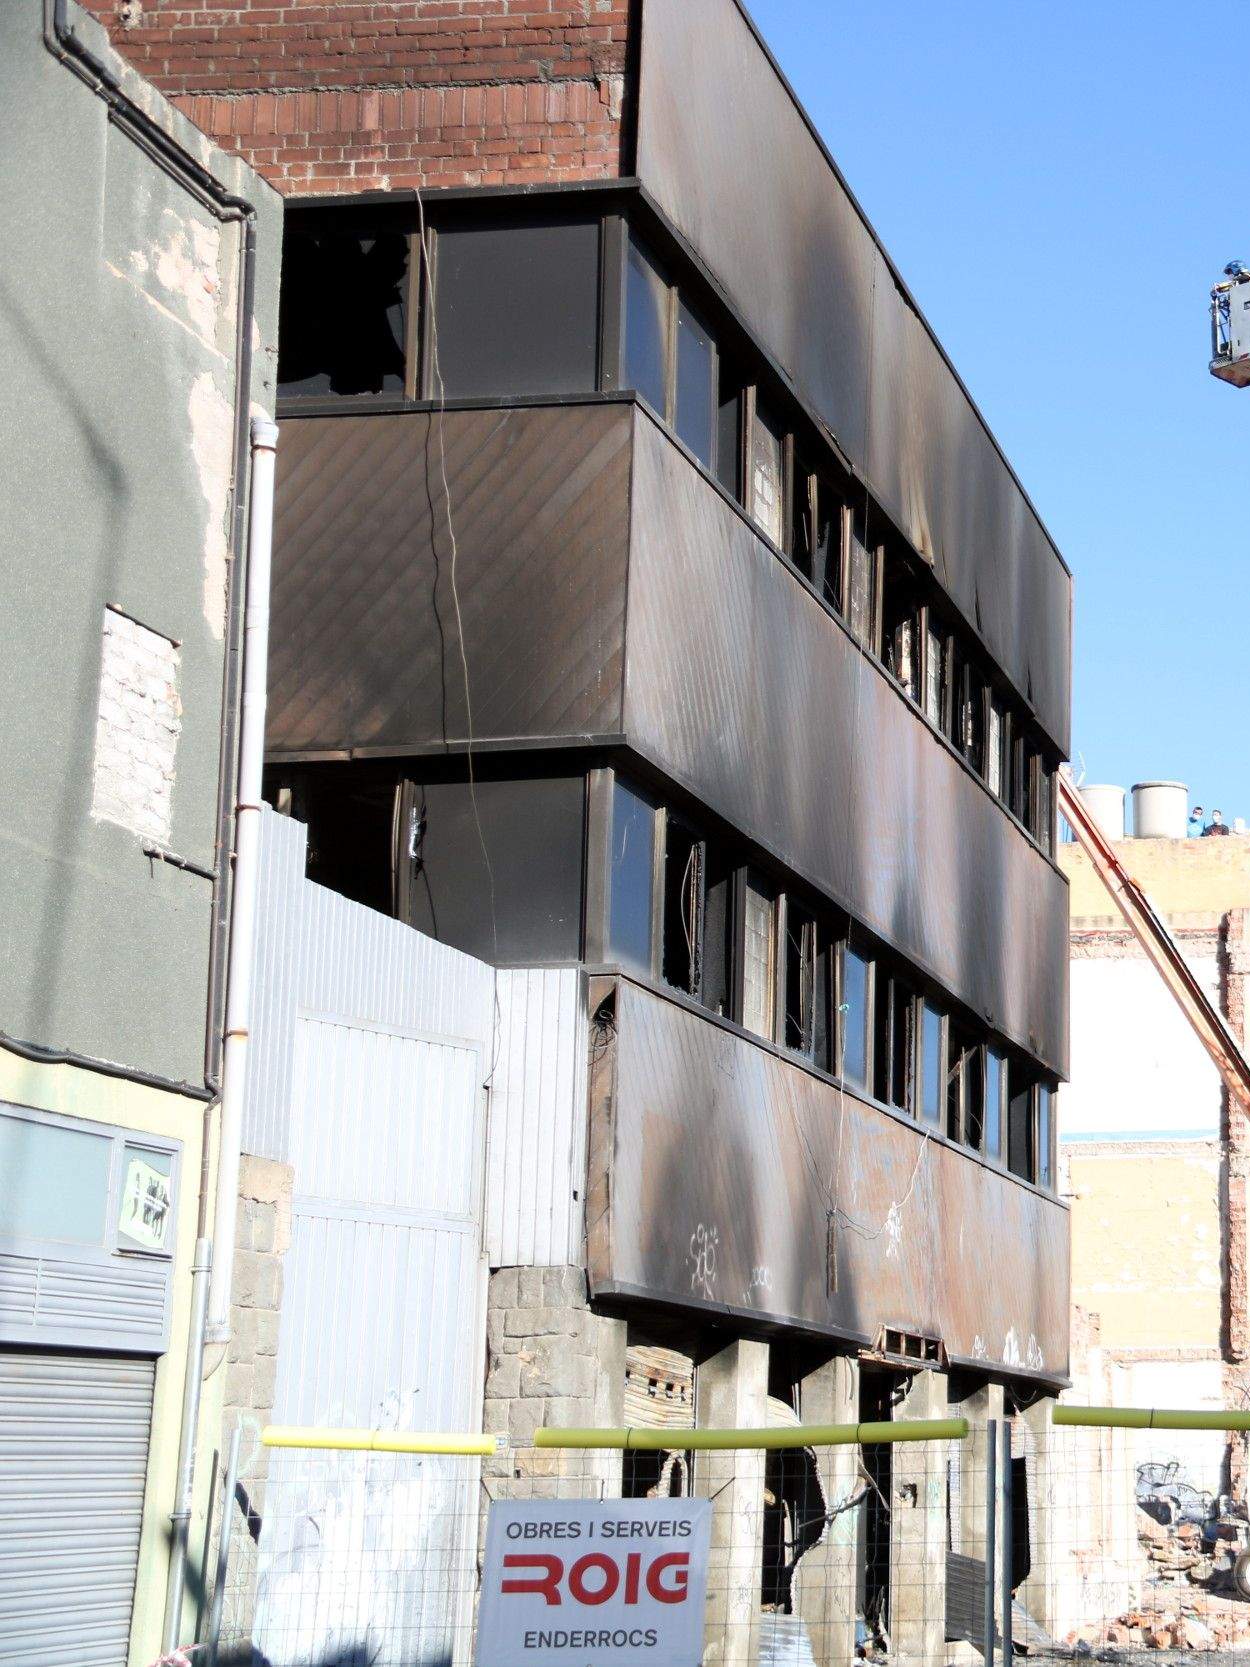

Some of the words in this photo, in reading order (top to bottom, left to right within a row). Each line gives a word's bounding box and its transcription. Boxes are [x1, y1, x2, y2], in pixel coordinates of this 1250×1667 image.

[506, 1520, 582, 1539] OBRES
[588, 1521, 594, 1538] I
[601, 1520, 692, 1539] SERVEIS
[501, 1552, 690, 1606] ROIG
[523, 1629, 658, 1649] ENDERROCS
